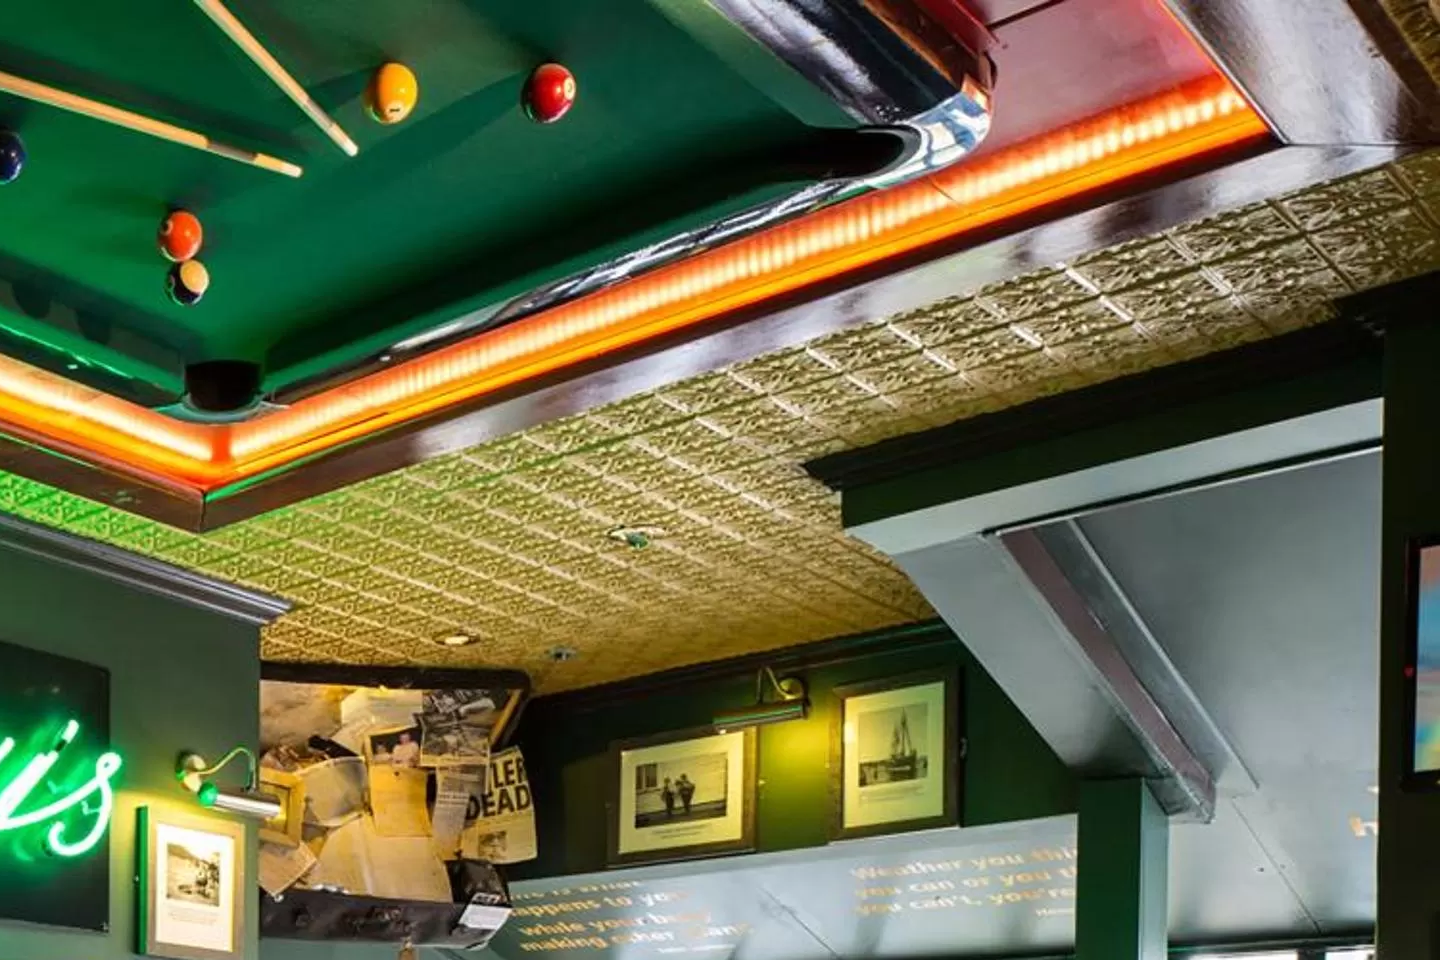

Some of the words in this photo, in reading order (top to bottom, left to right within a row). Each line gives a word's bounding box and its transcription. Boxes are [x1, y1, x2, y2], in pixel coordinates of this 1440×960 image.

[465, 785, 531, 820] DEAD
[971, 853, 1024, 871] you
[603, 896, 633, 907] to
[520, 921, 587, 936] while
[520, 936, 608, 952] making
